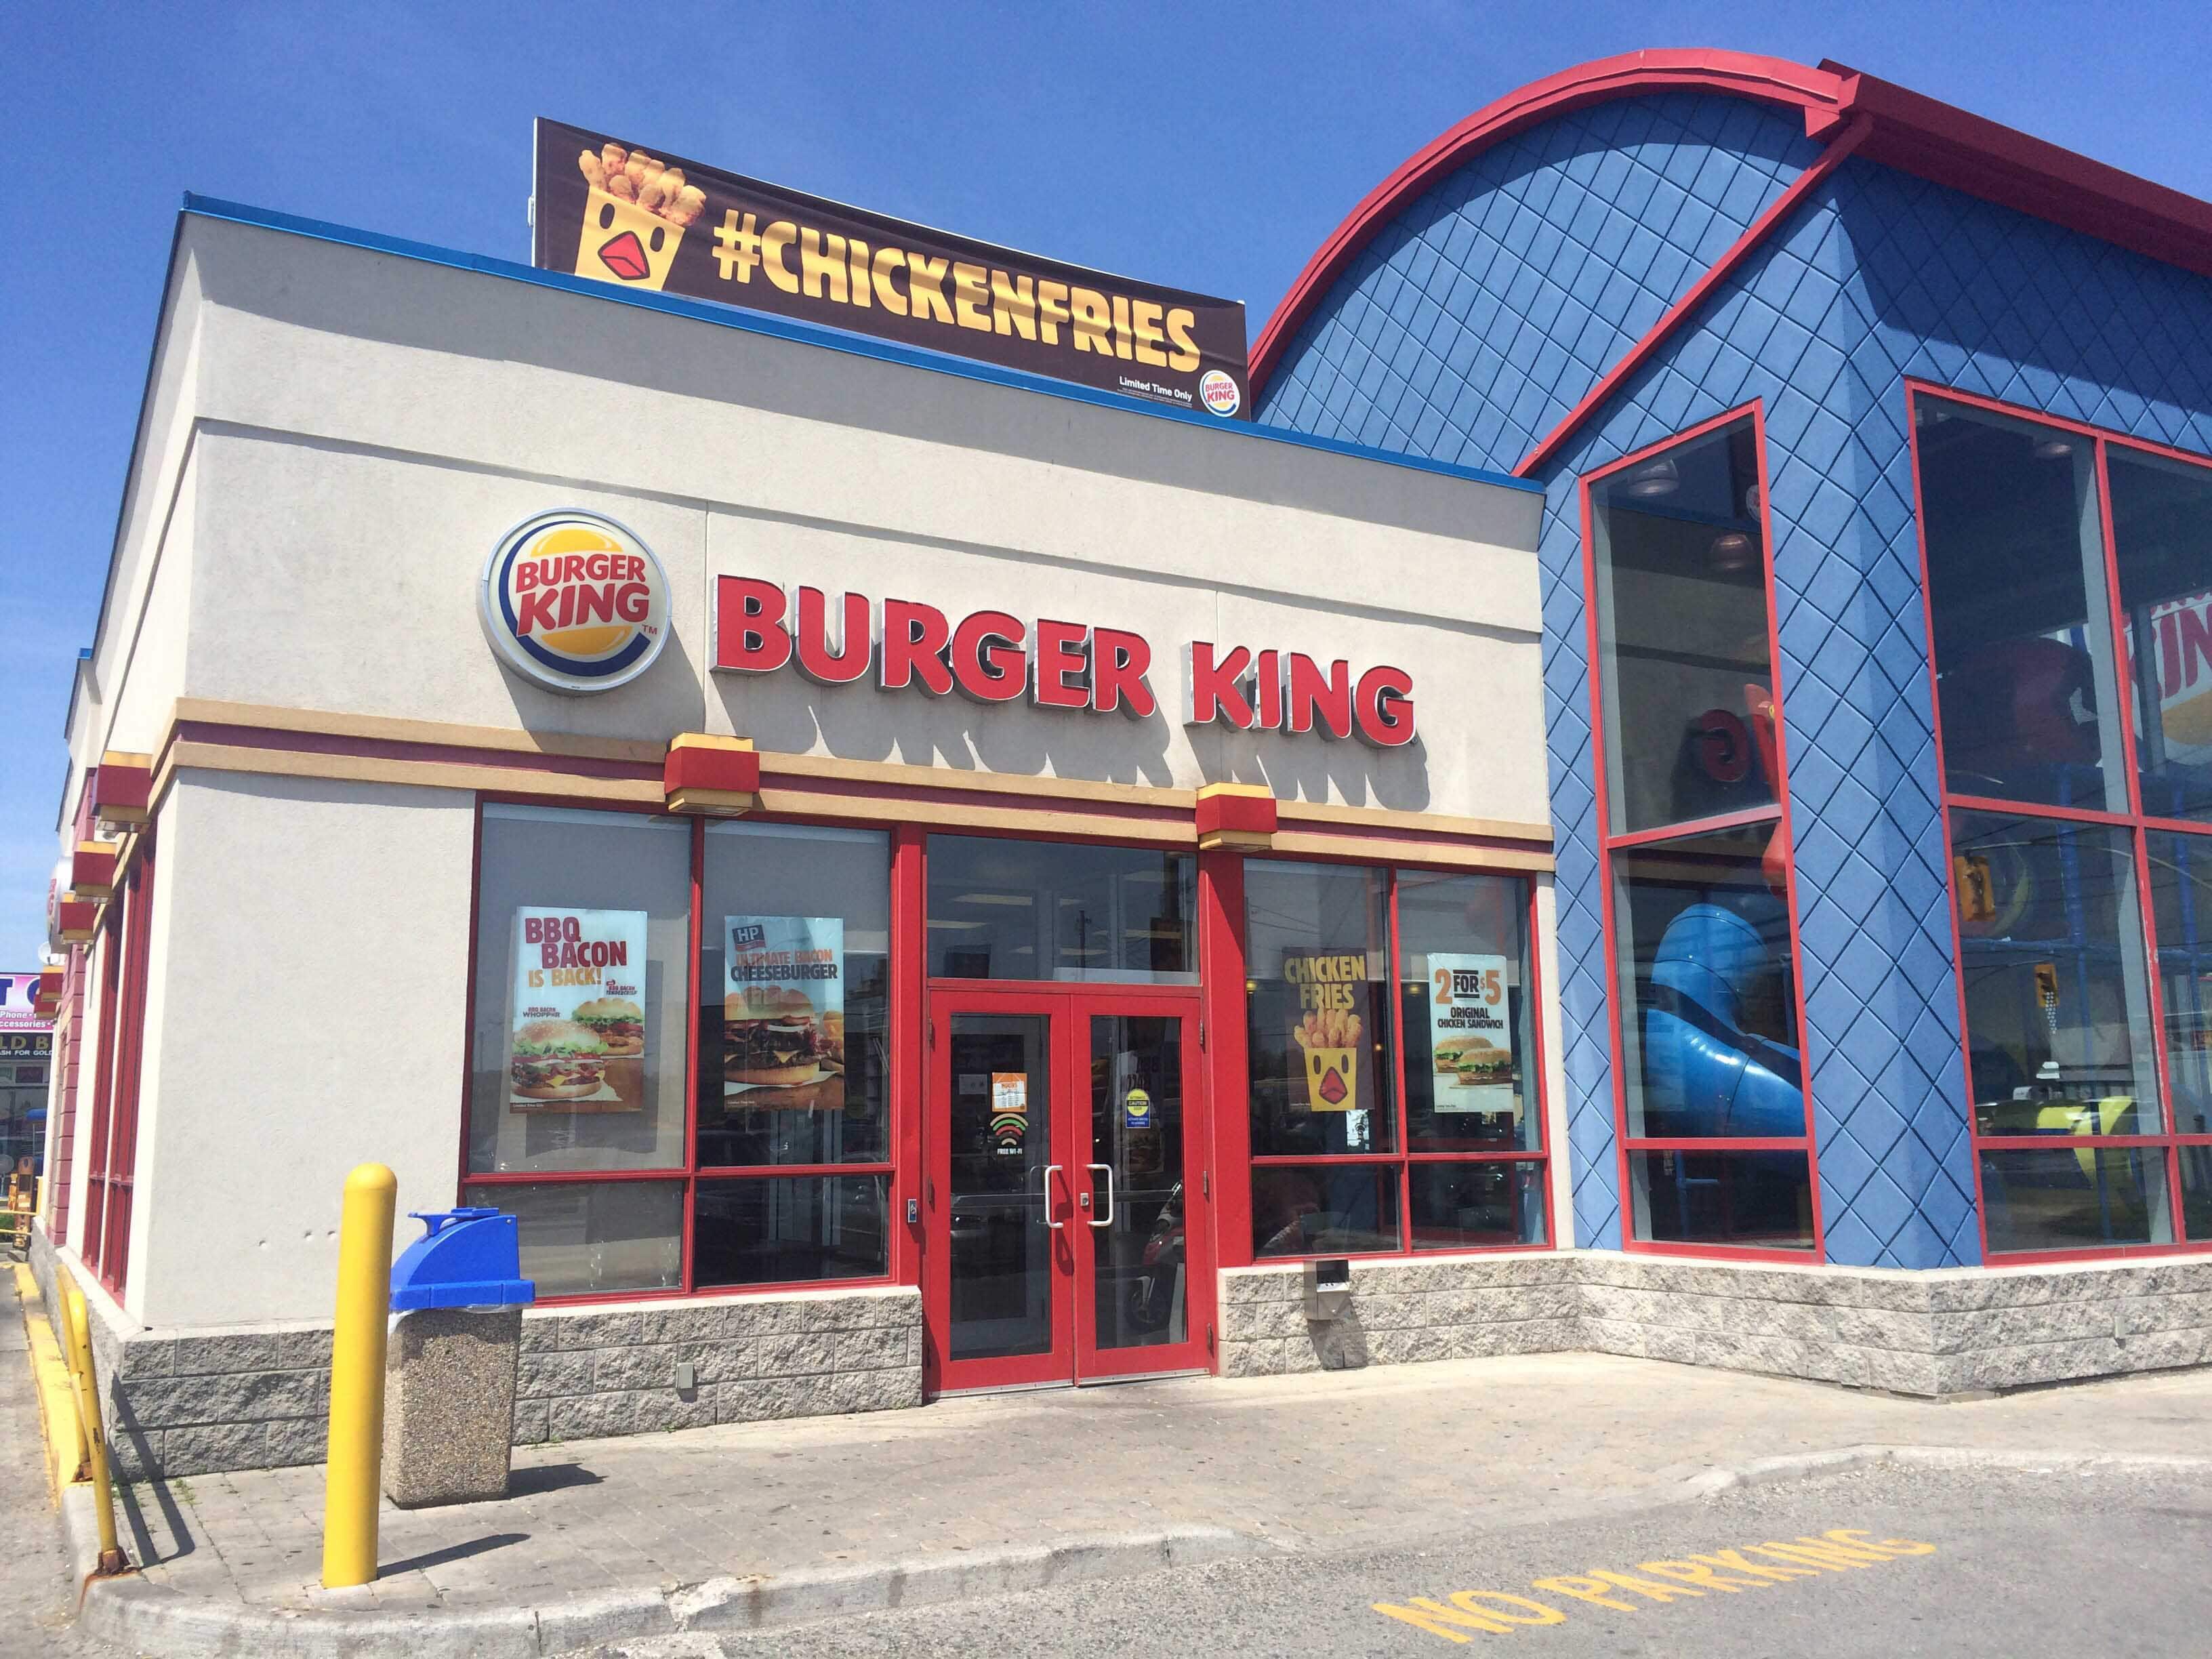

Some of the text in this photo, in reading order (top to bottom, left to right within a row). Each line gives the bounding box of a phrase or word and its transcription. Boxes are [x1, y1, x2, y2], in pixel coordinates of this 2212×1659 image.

[712, 208, 1201, 373] #CHICKENFRIES
[1120, 375, 1150, 391] Limited
[1152, 383, 1172, 396] Time
[1174, 389, 1193, 402] Only
[1205, 382, 1233, 392] BURGER
[1206, 390, 1235, 403] KING
[516, 554, 647, 592] BURGER
[516, 581, 651, 637] KING
[714, 573, 1416, 748] BURGER KING
[525, 916, 581, 944] BBQ
[737, 927, 759, 942] HP
[541, 941, 628, 969] BACON
[736, 949, 833, 966] ULTIMATE BACON
[528, 967, 602, 987] IS BACK!
[731, 964, 838, 982] CHEESEBURGER
[1284, 955, 1366, 984] CHICKEN
[1300, 983, 1355, 1009] FRIES
[1435, 968, 1452, 1004] 2
[1453, 975, 1479, 993] FOR
[1437, 1019, 1504, 1029] CHICKEN SANDWICH
[1450, 1007, 1490, 1019] ORIGINAL
[1370, 1529, 1936, 1644] NO PARKING
